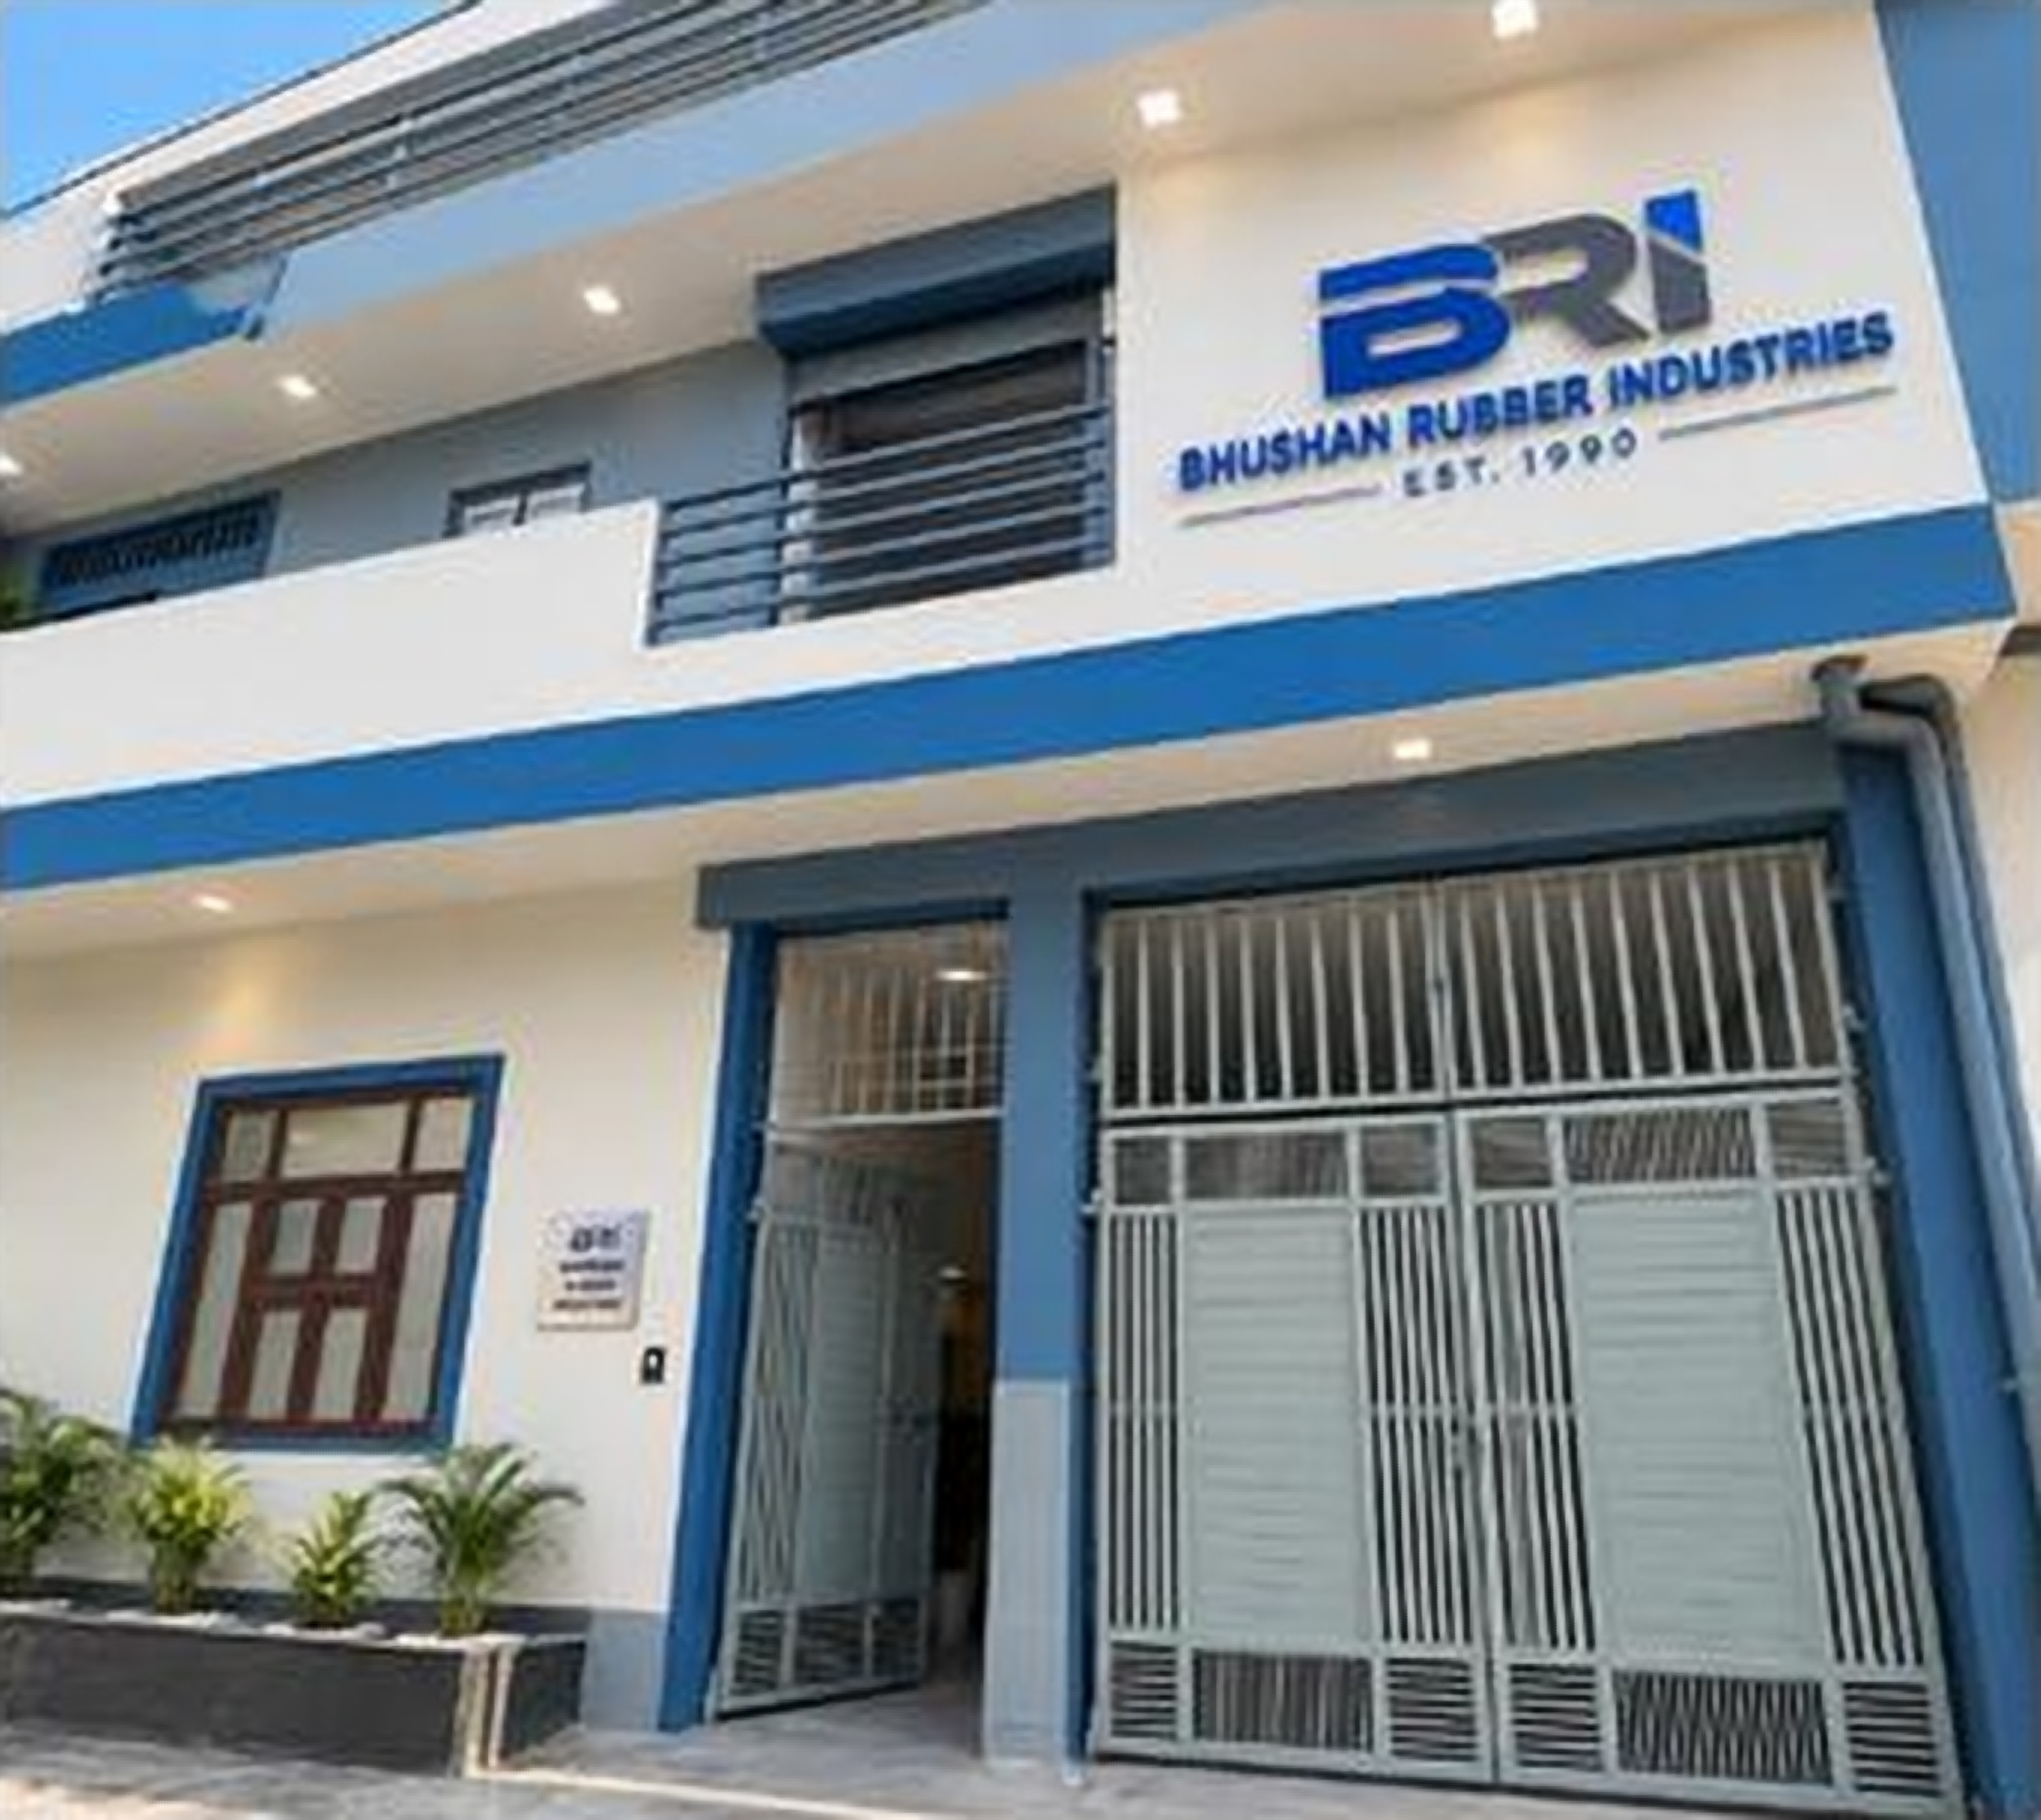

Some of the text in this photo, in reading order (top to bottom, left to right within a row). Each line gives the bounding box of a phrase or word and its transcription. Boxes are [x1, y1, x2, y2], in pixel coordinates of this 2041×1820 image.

[1319, 189, 1711, 399] BRI
[1178, 311, 1894, 491] BHUSHAN RUBBER INDUSTRIES
[1404, 427, 1637, 498] EST. 1990
